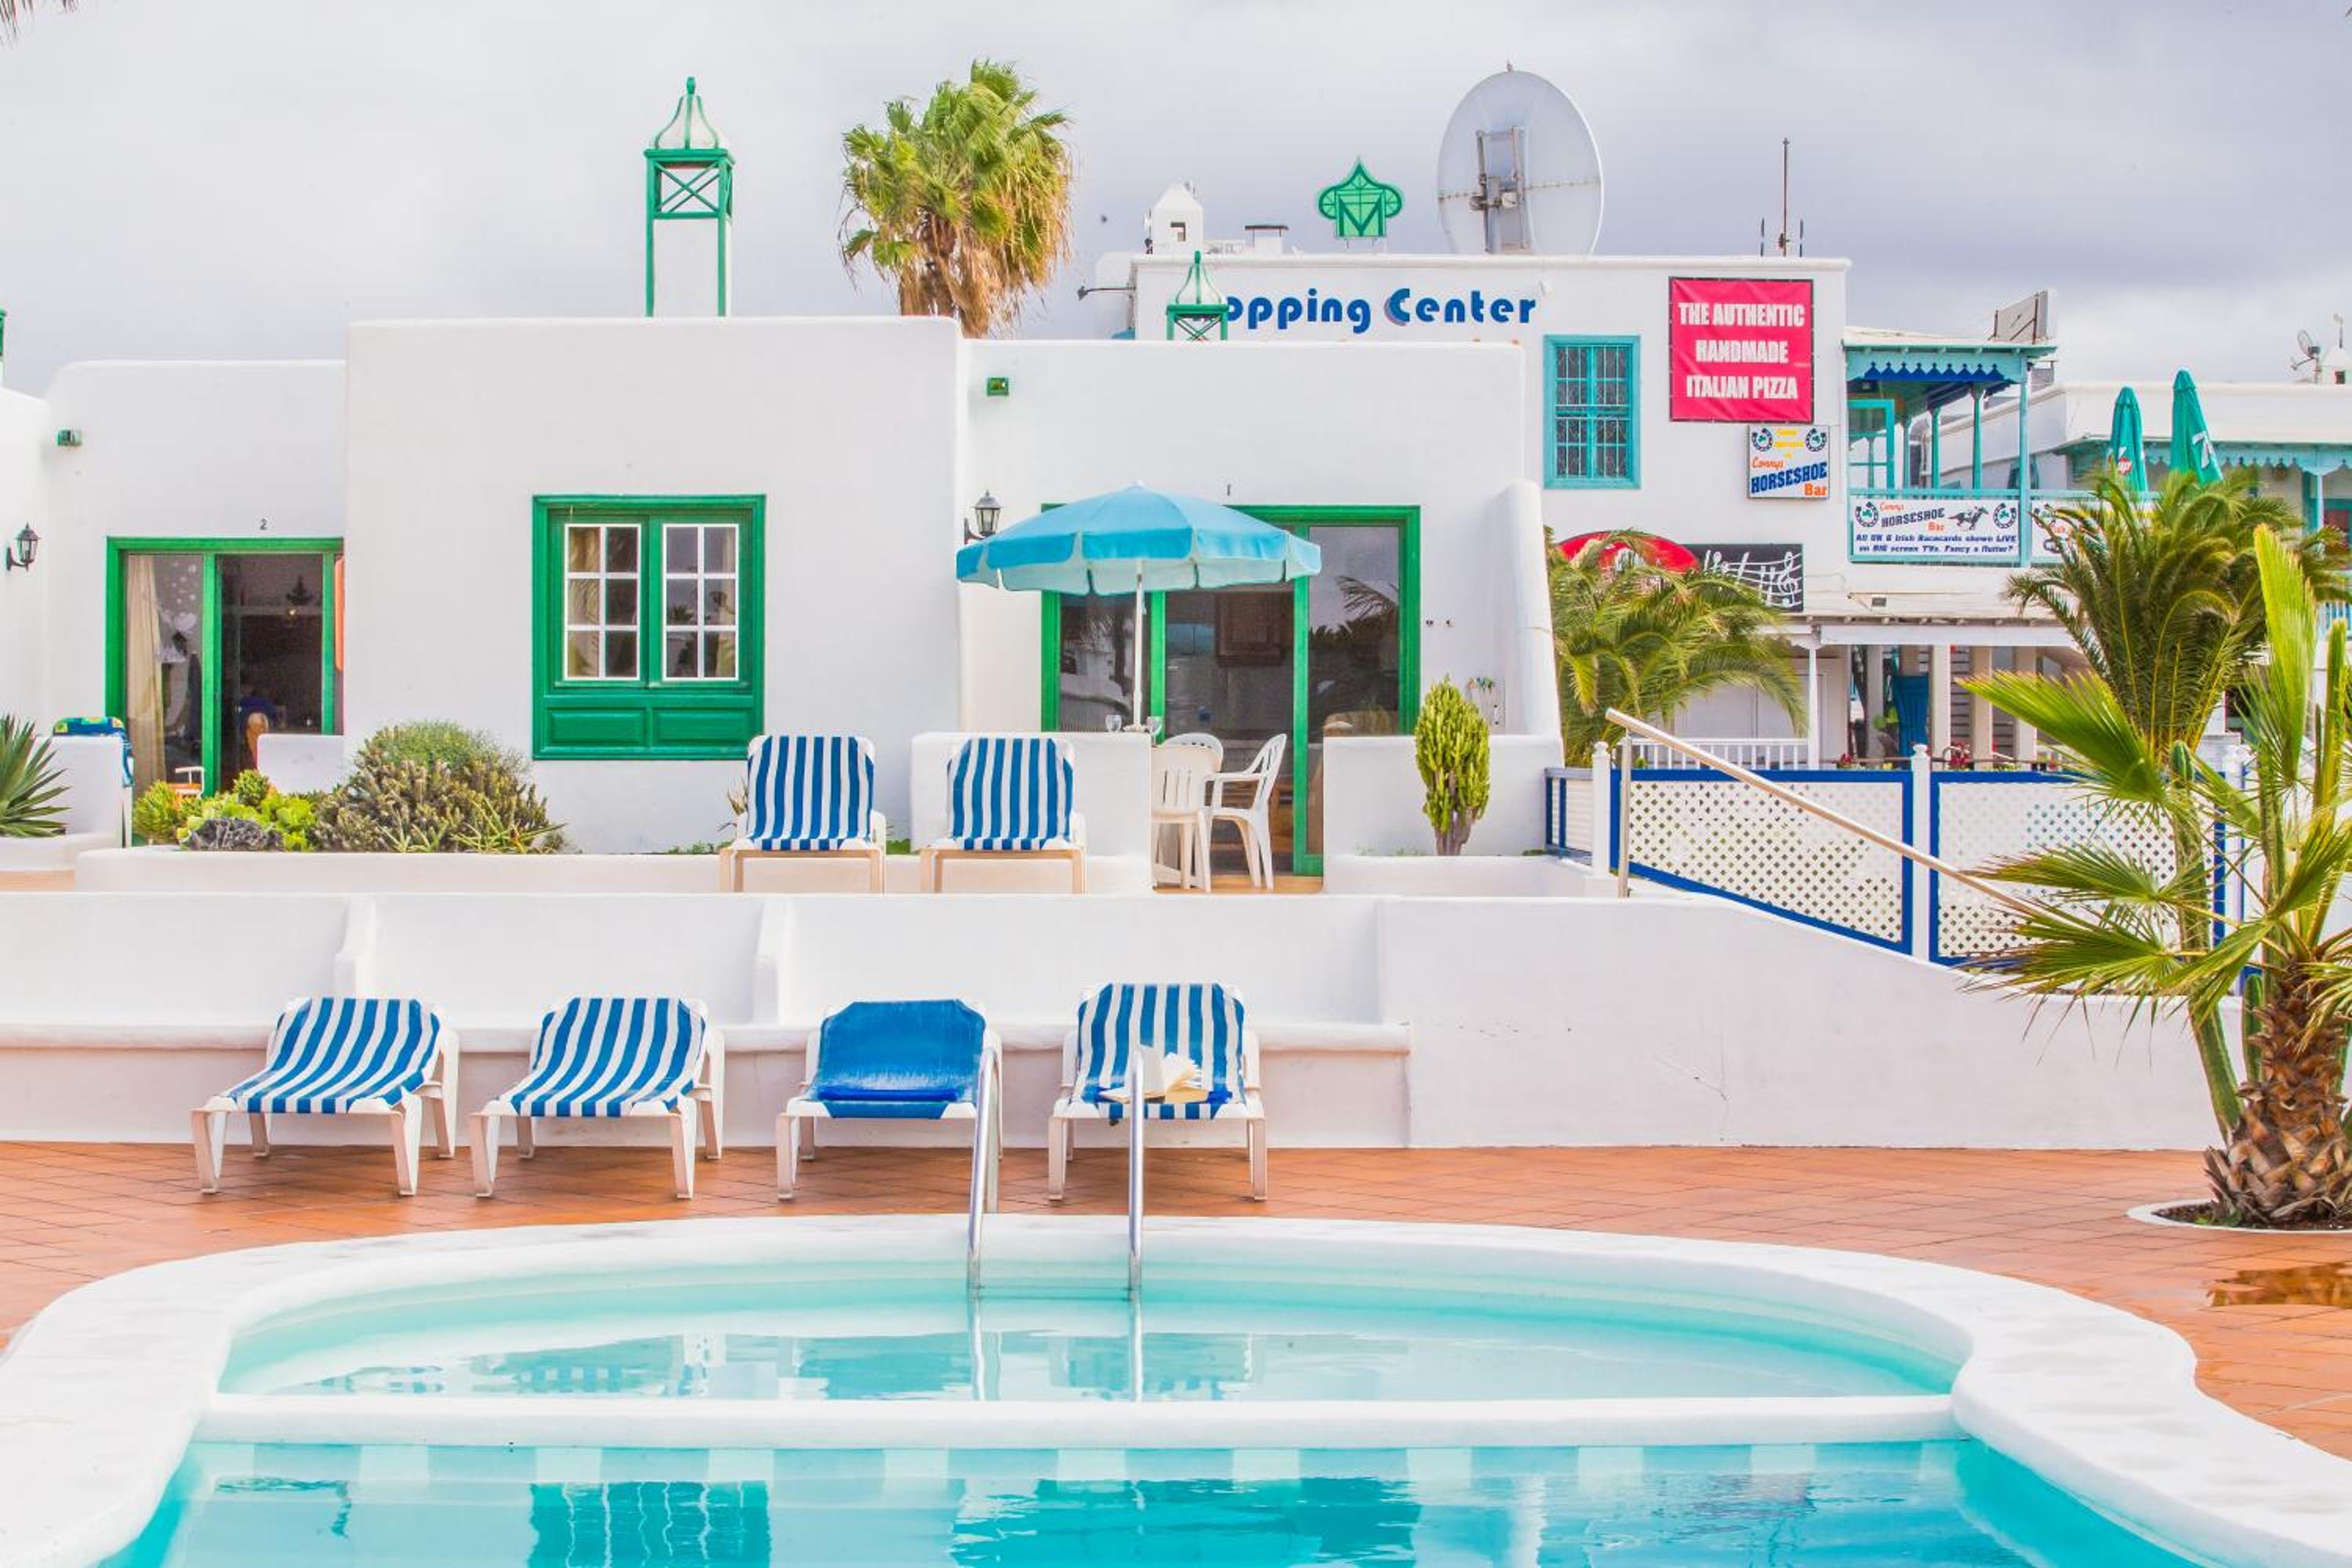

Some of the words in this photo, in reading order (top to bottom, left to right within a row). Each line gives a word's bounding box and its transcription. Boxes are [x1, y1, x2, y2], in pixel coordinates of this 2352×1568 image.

[1227, 288, 1370, 333] opping
[1385, 289, 1536, 325] Center
[1678, 303, 1710, 325] THE
[1712, 303, 1805, 327] AUTHENTIC
[1696, 339, 1788, 363] HANDMADE
[1686, 376, 1749, 398] ITALIAN
[1753, 376, 1798, 399] PIZZA
[1751, 462, 1828, 494] HORSESHOE
[1805, 483, 1827, 495] Bar
[260, 518, 267, 531] 2
[1882, 508, 1945, 528] HORSESHOE
[1928, 522, 1945, 531] Bar
